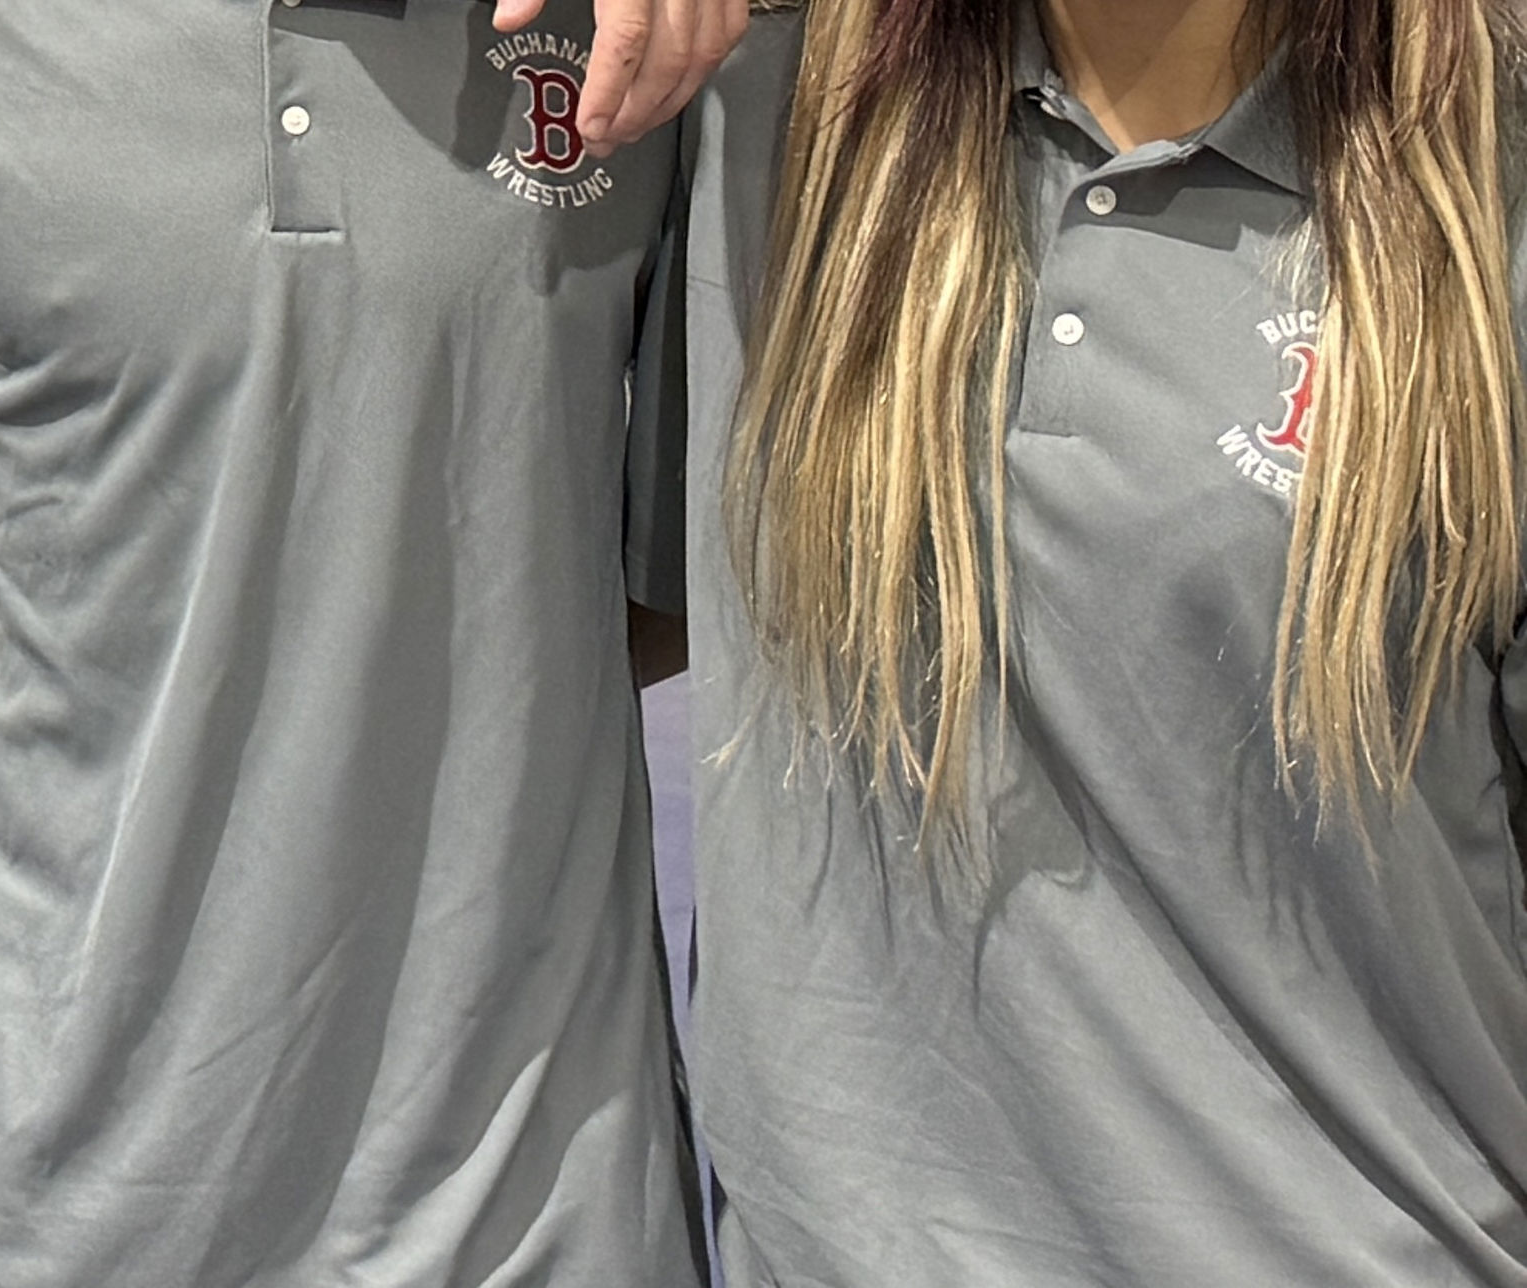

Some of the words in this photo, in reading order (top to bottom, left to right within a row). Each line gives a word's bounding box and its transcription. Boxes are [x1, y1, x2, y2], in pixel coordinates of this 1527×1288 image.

[485, 32, 589, 71] BUCHANA
[512, 64, 587, 174] B
[485, 152, 615, 209] WRESTLING
